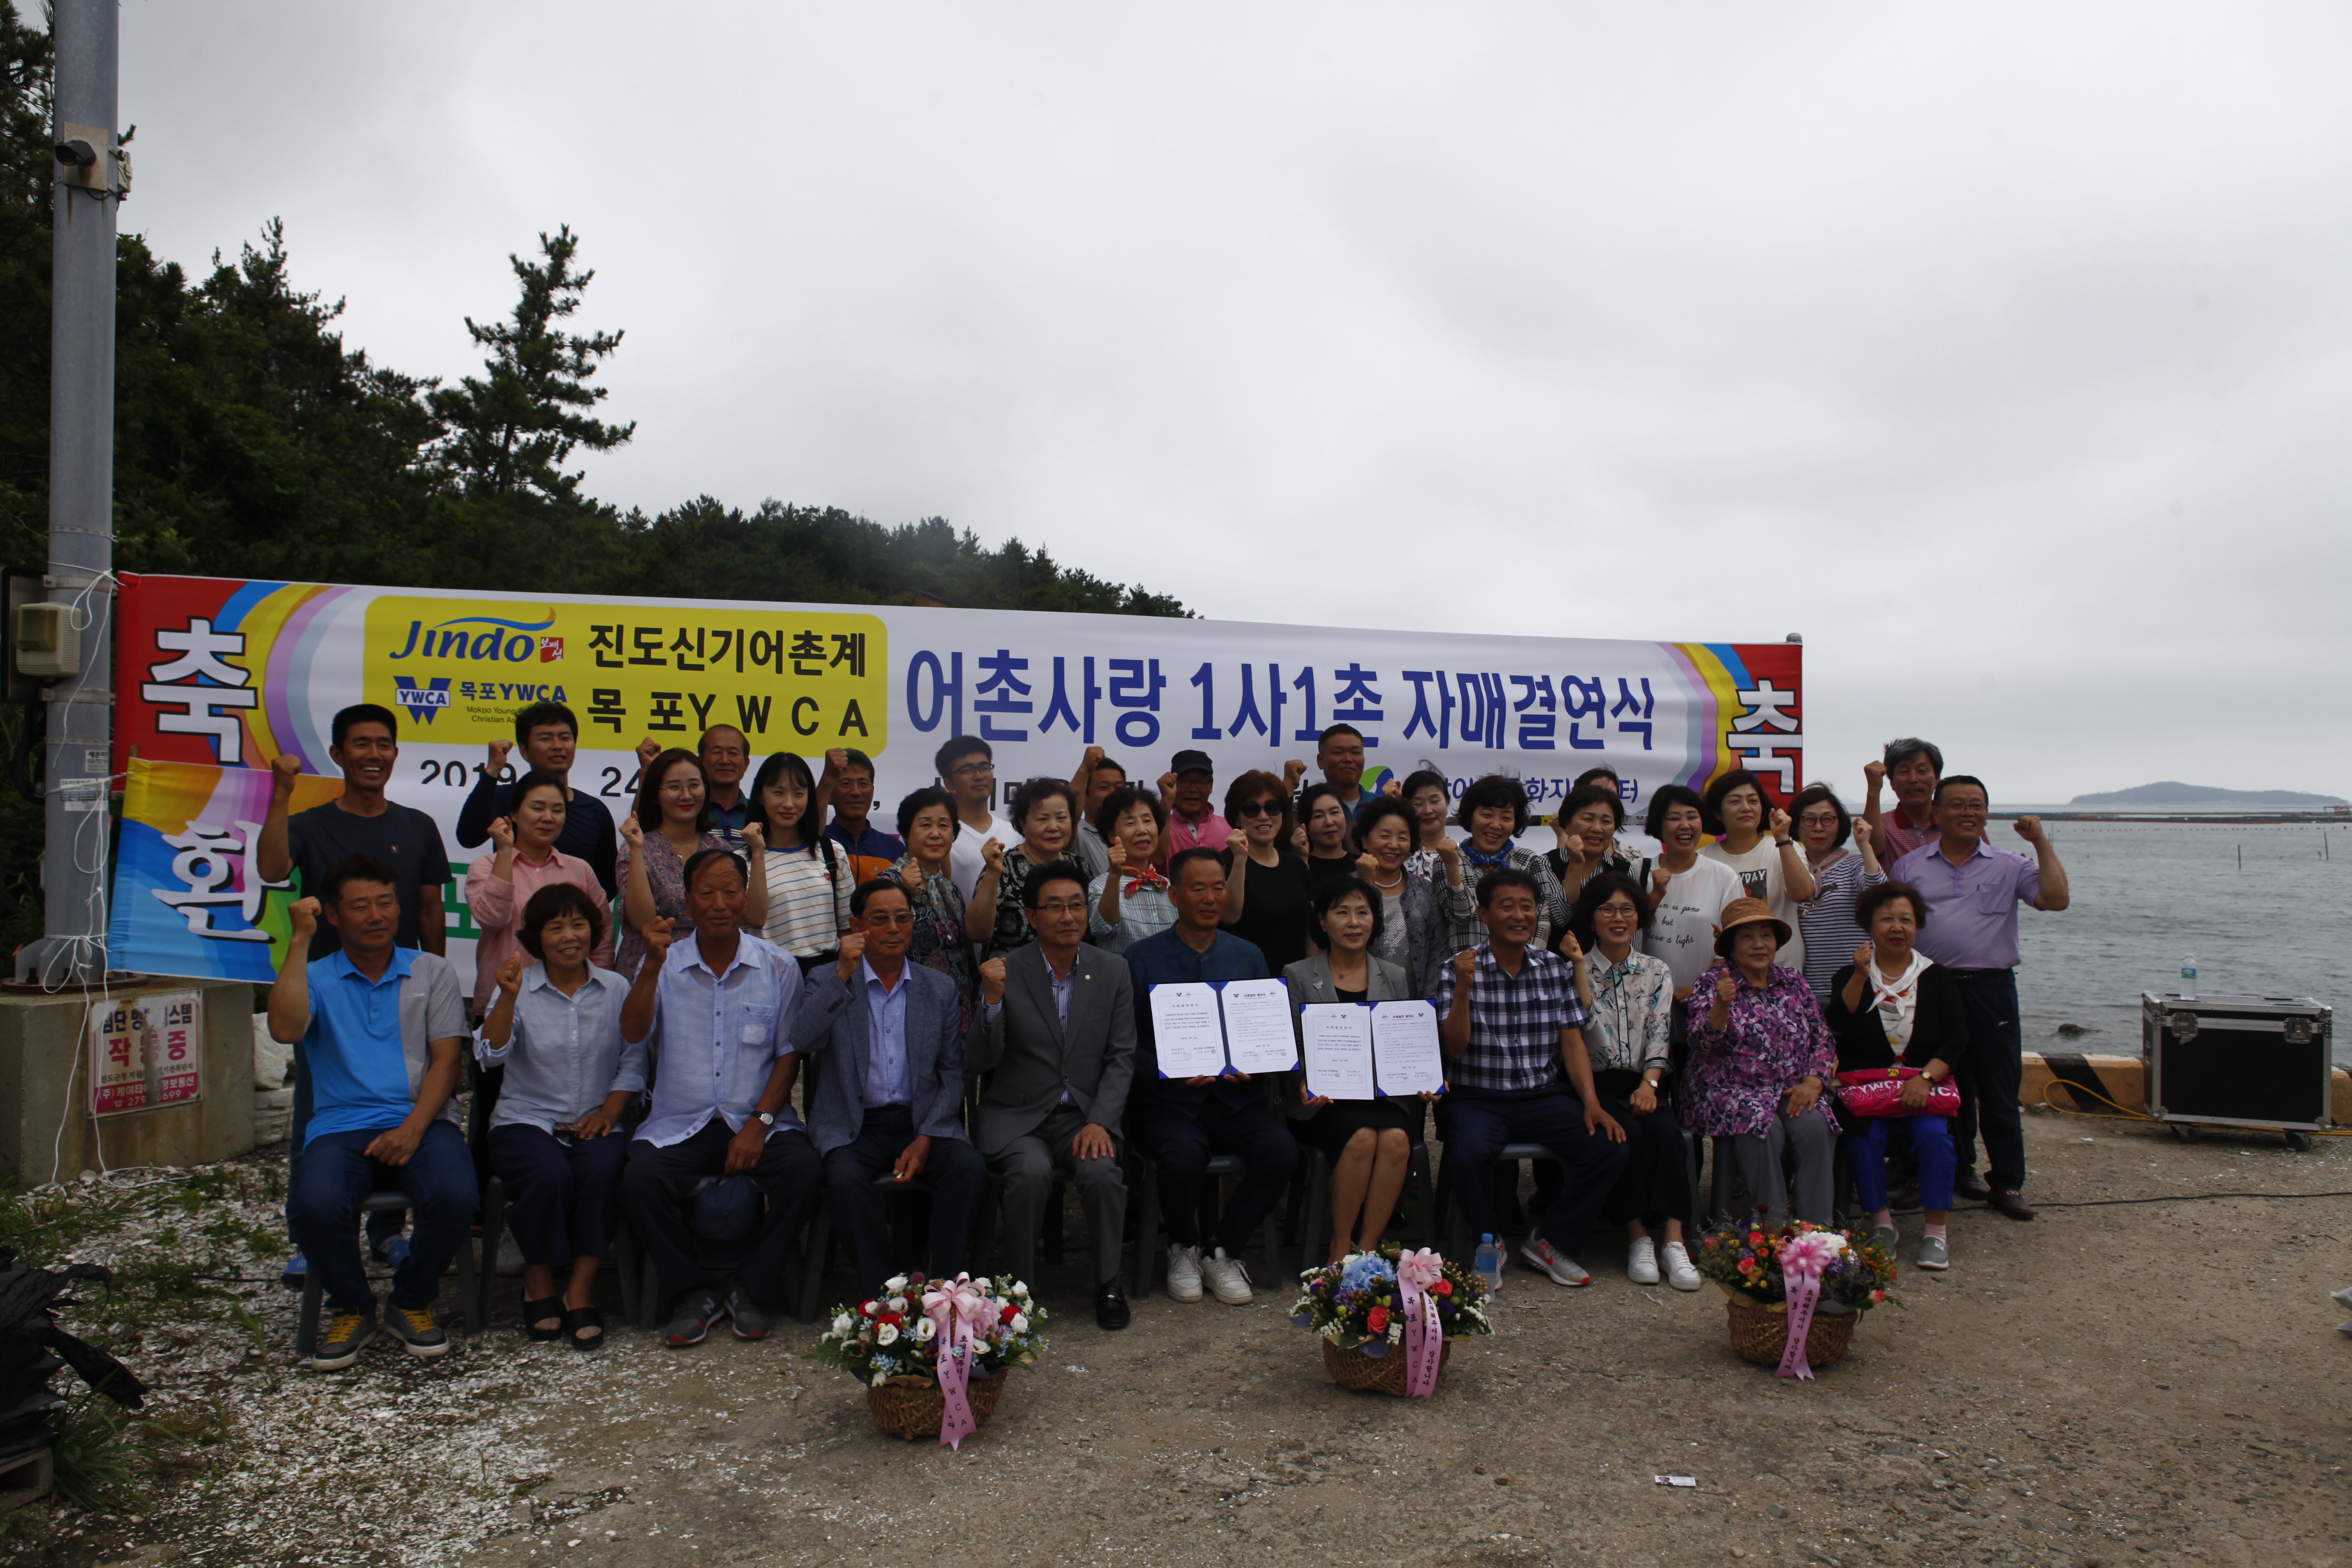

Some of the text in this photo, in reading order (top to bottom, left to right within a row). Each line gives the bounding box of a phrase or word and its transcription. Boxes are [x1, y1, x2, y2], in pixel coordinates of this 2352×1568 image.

[389, 621, 535, 662] Jindo
[588, 624, 866, 677] 진도신기어촌계
[140, 616, 258, 765] 축
[399, 691, 447, 705] YWCA
[459, 681, 568, 703] 목포YWCA
[906, 649, 1654, 751] 어촌사랑 1사1촌 자매결연식
[467, 706, 492, 714] Mokpo
[472, 715, 504, 723] Christian
[1726, 678, 1802, 794] 축
[1672, 902, 1679, 910] is
[1681, 905, 1701, 915] gone
[1661, 915, 1674, 927] but
[1675, 934, 1695, 949] light
